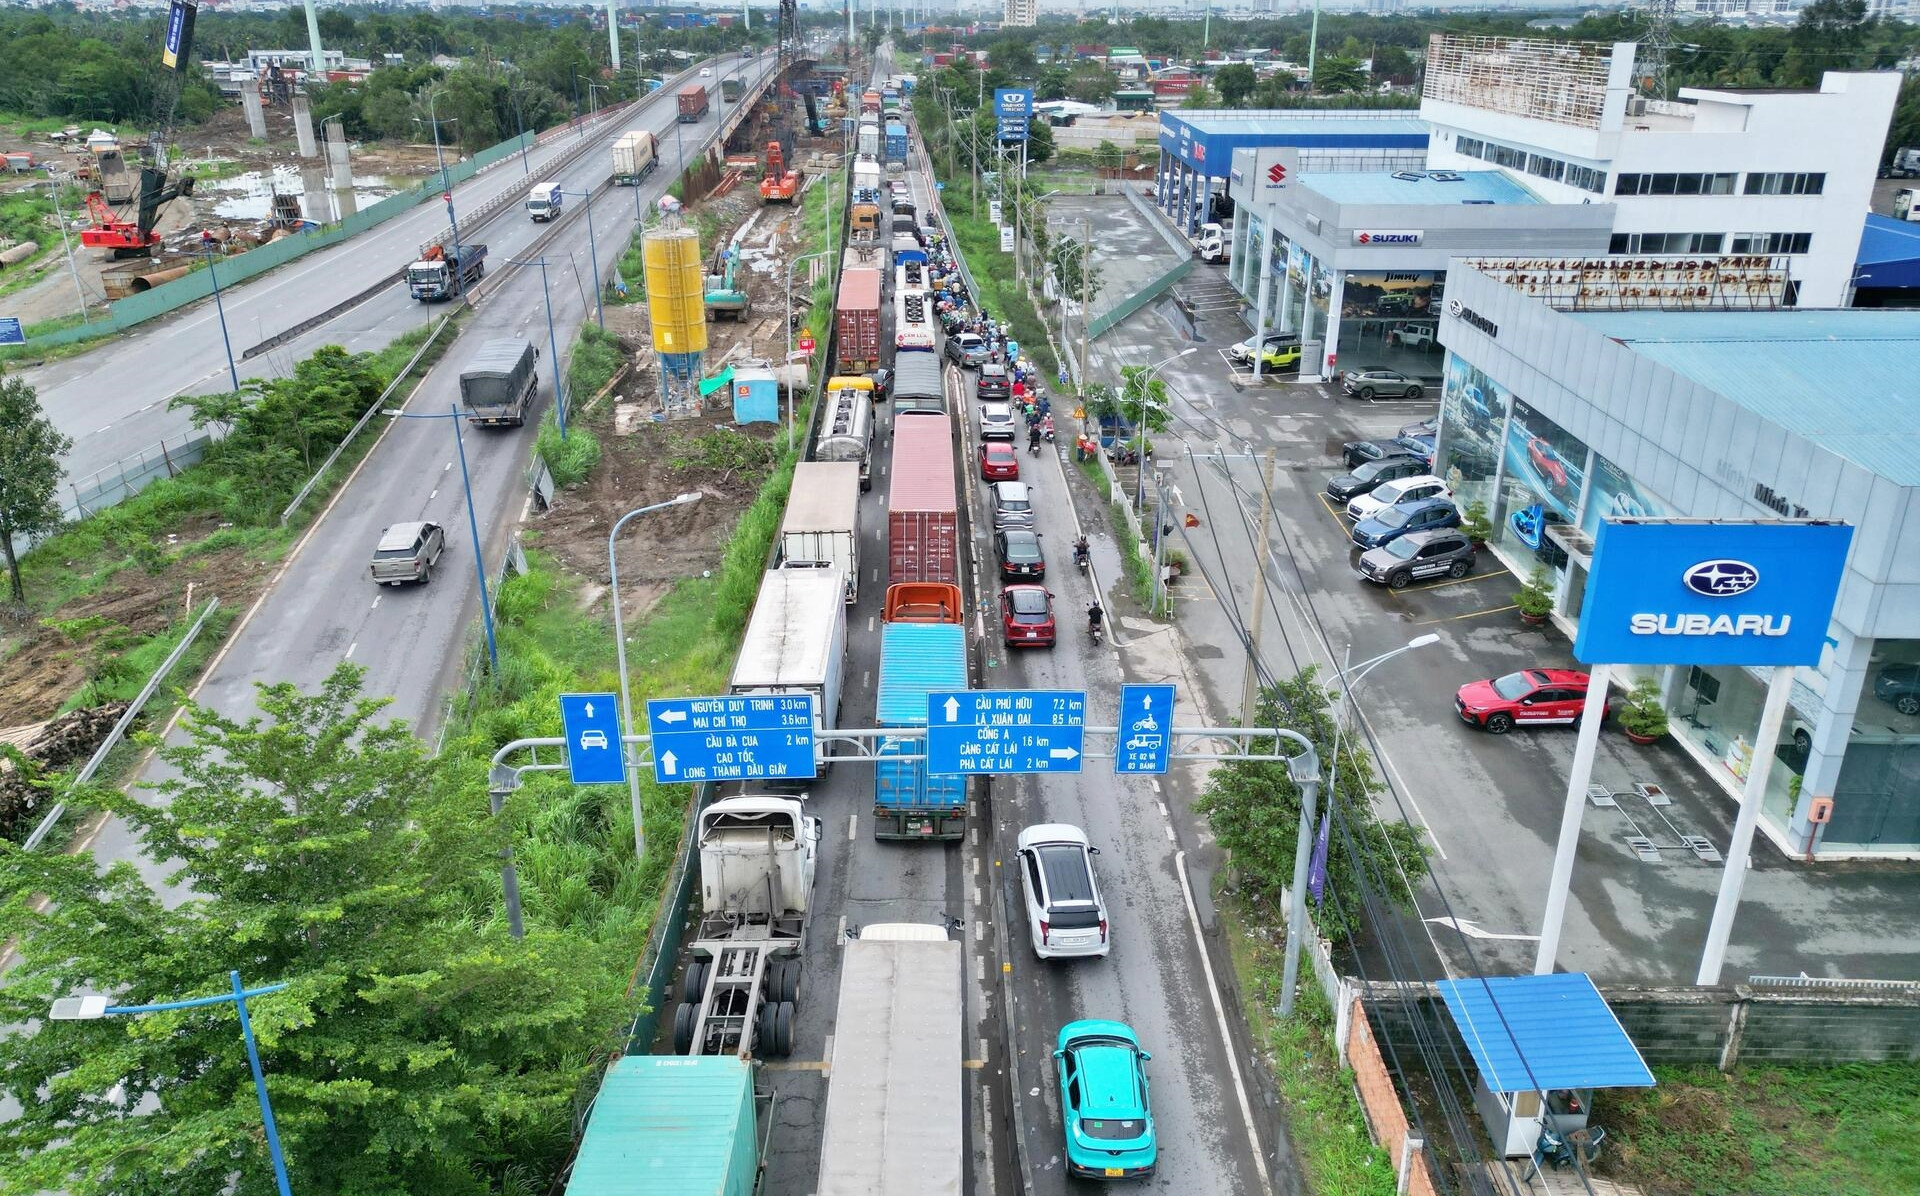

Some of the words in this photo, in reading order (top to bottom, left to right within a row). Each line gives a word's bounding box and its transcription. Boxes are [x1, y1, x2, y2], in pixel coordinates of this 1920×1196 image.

[1372, 234, 1418, 243] SUZUKI
[1462, 307, 1498, 338] SUBARU
[1515, 402, 1529, 416] BRZ
[1599, 457, 1624, 477] OUTBACK
[1630, 613, 1791, 636] SUBARU
[729, 700, 745, 712] DUY
[751, 699, 774, 711] TRINH
[780, 699, 793, 710] 3.0
[793, 699, 807, 709] km
[975, 694, 992, 710] CẦU
[996, 696, 1011, 710] PHÚ
[1053, 698, 1065, 710] 7.2
[1069, 699, 1081, 710] km
[693, 717, 709, 729] MAI
[713, 714, 726, 728] CHÍ
[730, 715, 747, 729] THỌ
[782, 715, 794, 725] 3.6
[794, 714, 808, 725] km
[991, 712, 1013, 725] XUÂN
[1017, 713, 1031, 725] OAI
[1052, 713, 1064, 724] 8.5
[1068, 714, 1081, 724] km
[706, 733, 722, 748] CẦU
[726, 733, 738, 747] BÀ
[742, 735, 758, 747] CUA
[786, 735, 792, 745] 2
[795, 734, 809, 745] km
[1003, 729, 1010, 739] A
[1023, 736, 1032, 746] 1.6
[1036, 736, 1049, 746] km
[985, 741, 1000, 754] CÁT
[1004, 741, 1017, 754] LÁI
[716, 752, 733, 764] CAO
[960, 756, 976, 770] PHÀ
[980, 756, 995, 769] CÁT
[999, 756, 1012, 769] LÁI
[1026, 758, 1032, 768] 2
[1035, 758, 1049, 768] km
[1129, 752, 1137, 760] XE
[1139, 752, 1147, 760] 02
[683, 767, 706, 778] LONG
[712, 763, 741, 777] THÀNH
